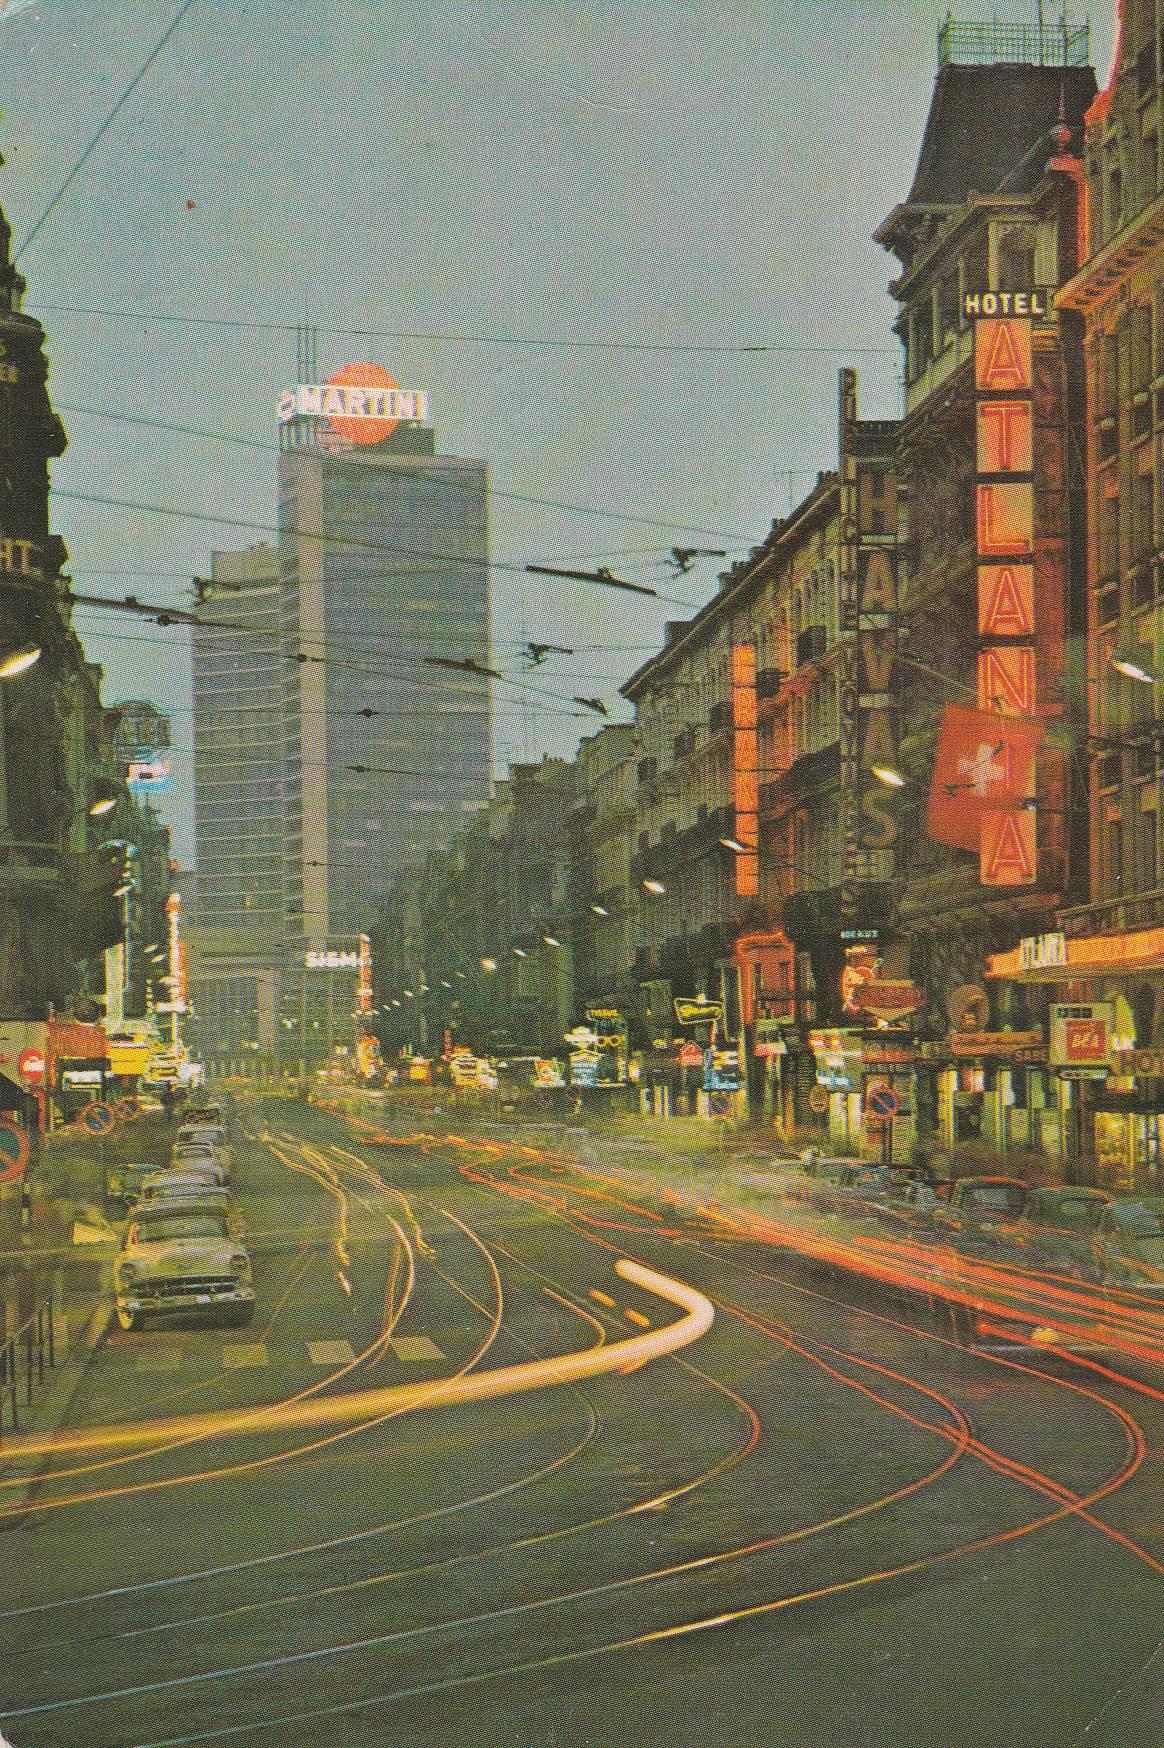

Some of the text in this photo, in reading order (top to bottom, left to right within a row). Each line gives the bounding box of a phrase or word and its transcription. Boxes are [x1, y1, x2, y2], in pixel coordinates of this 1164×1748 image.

[300, 385, 431, 420] MARTINI
[965, 293, 1044, 315] HOTEL
[859, 473, 898, 848] HAVAS
[978, 321, 1034, 878] ATLANTA
